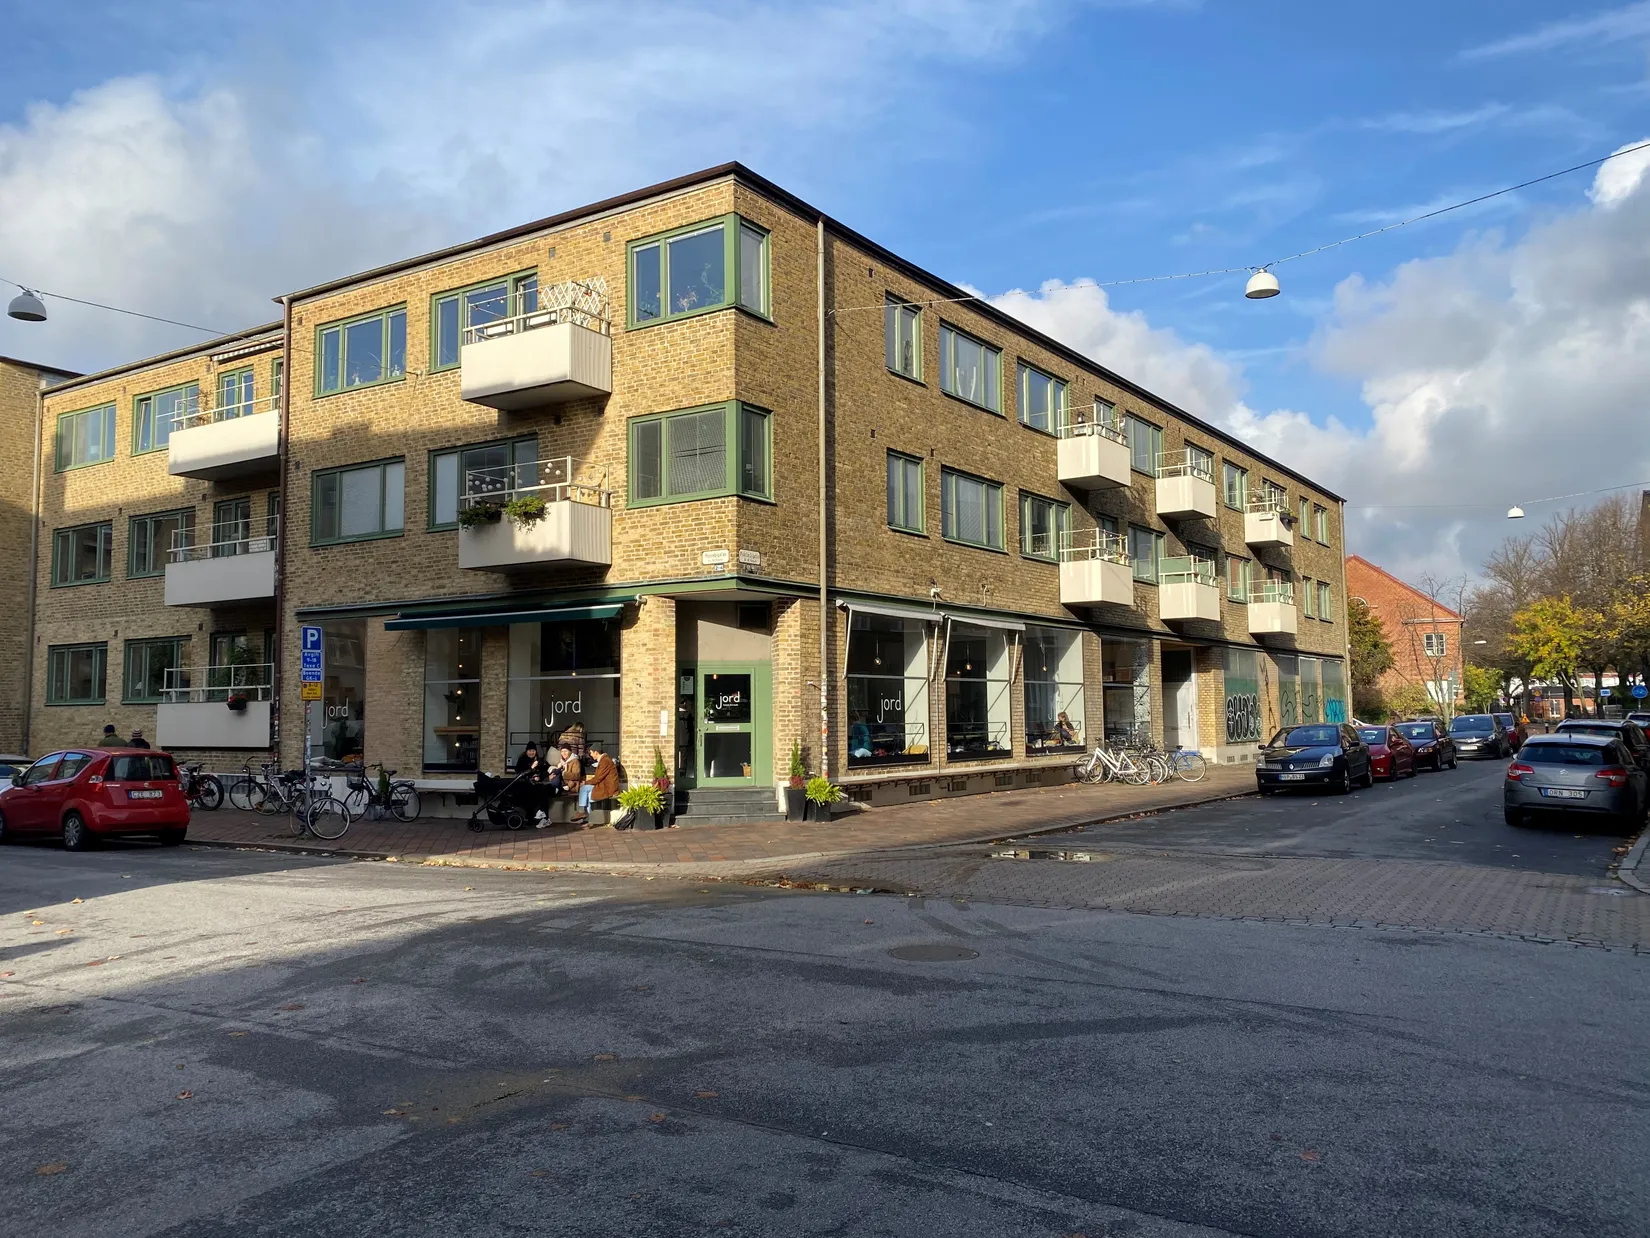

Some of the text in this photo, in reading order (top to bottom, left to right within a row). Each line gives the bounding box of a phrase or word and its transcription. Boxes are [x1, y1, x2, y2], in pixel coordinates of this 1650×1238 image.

[306, 629, 319, 649] P
[321, 697, 349, 729] jord
[545, 690, 581, 727] jord
[715, 690, 741, 710] jord
[876, 690, 902, 723] jord
